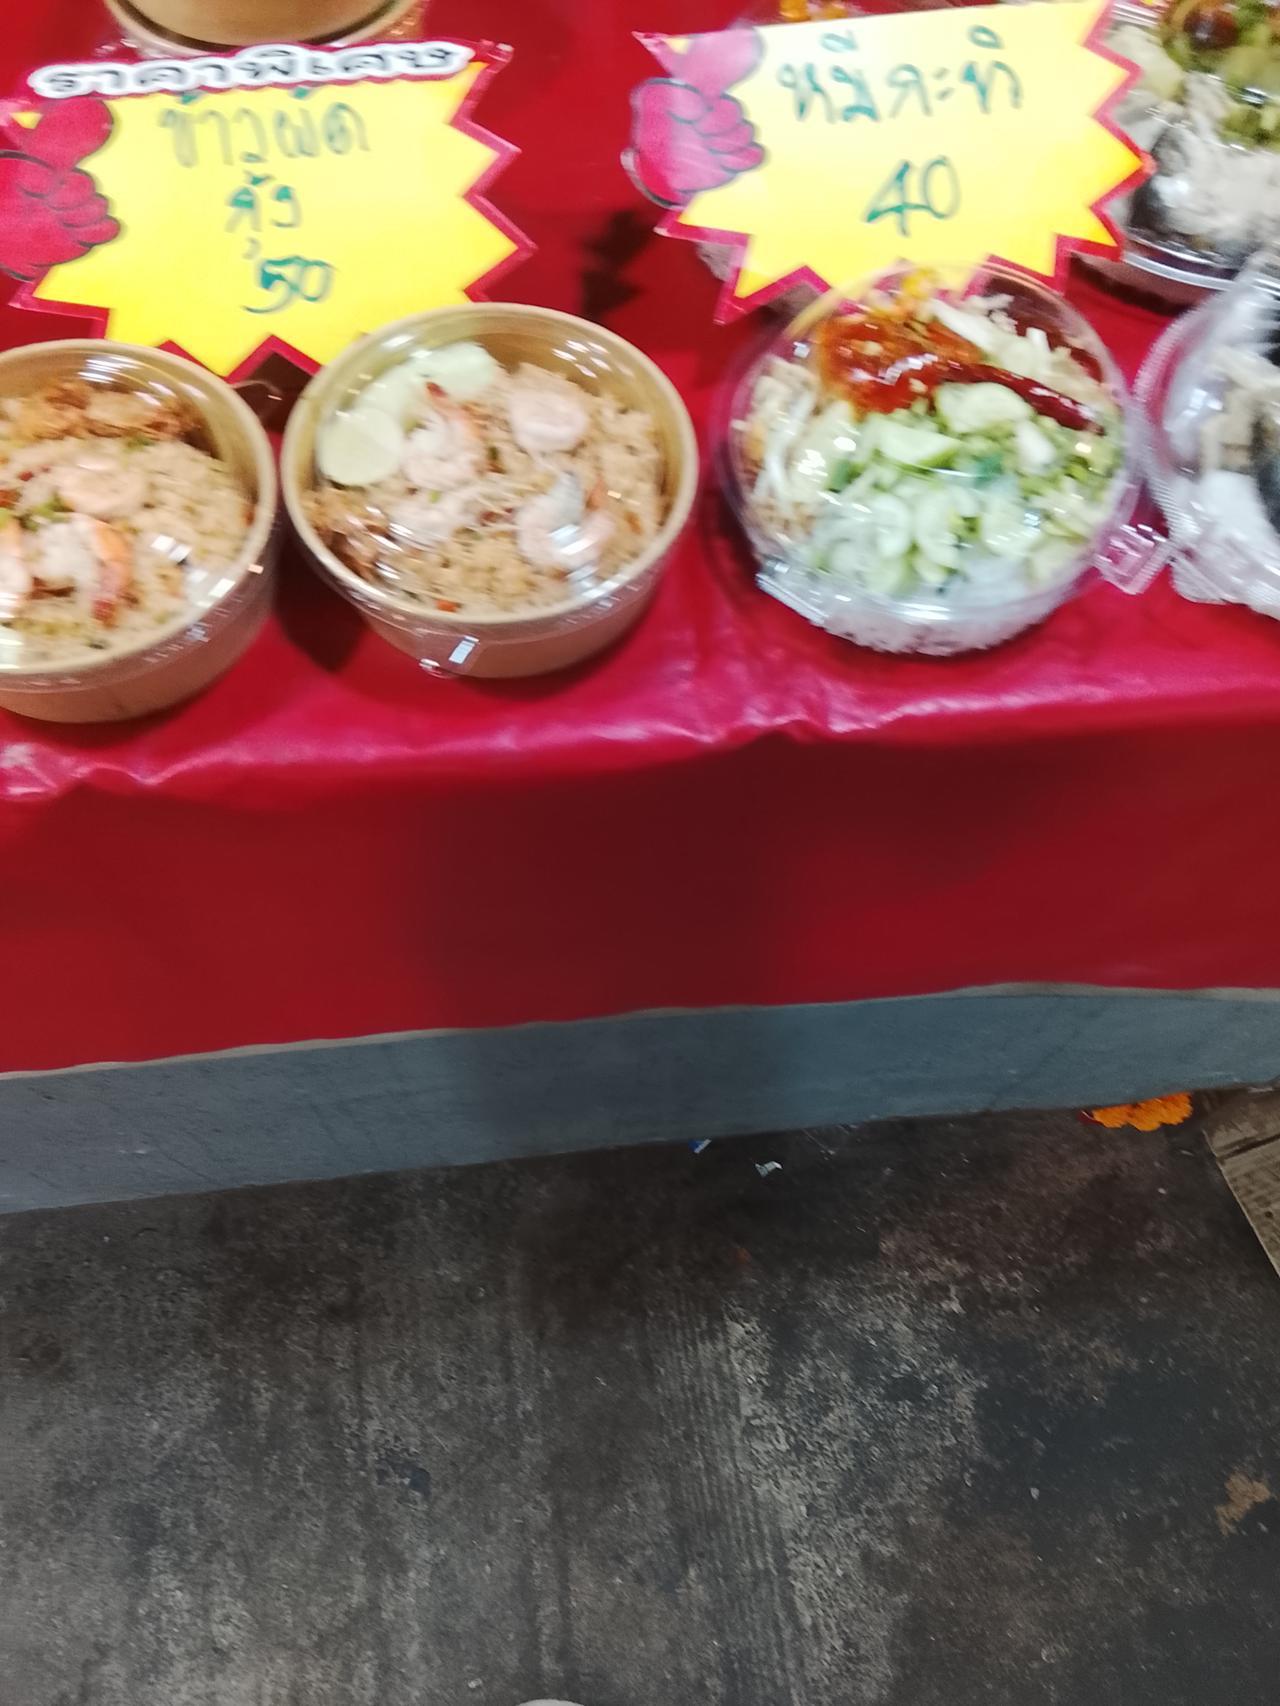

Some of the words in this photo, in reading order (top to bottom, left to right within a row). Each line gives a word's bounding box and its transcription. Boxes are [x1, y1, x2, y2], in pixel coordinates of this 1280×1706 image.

[42, 44, 458, 95] ราคาพิเศษ
[862, 155, 961, 240] 40
[242, 254, 341, 313] 50
